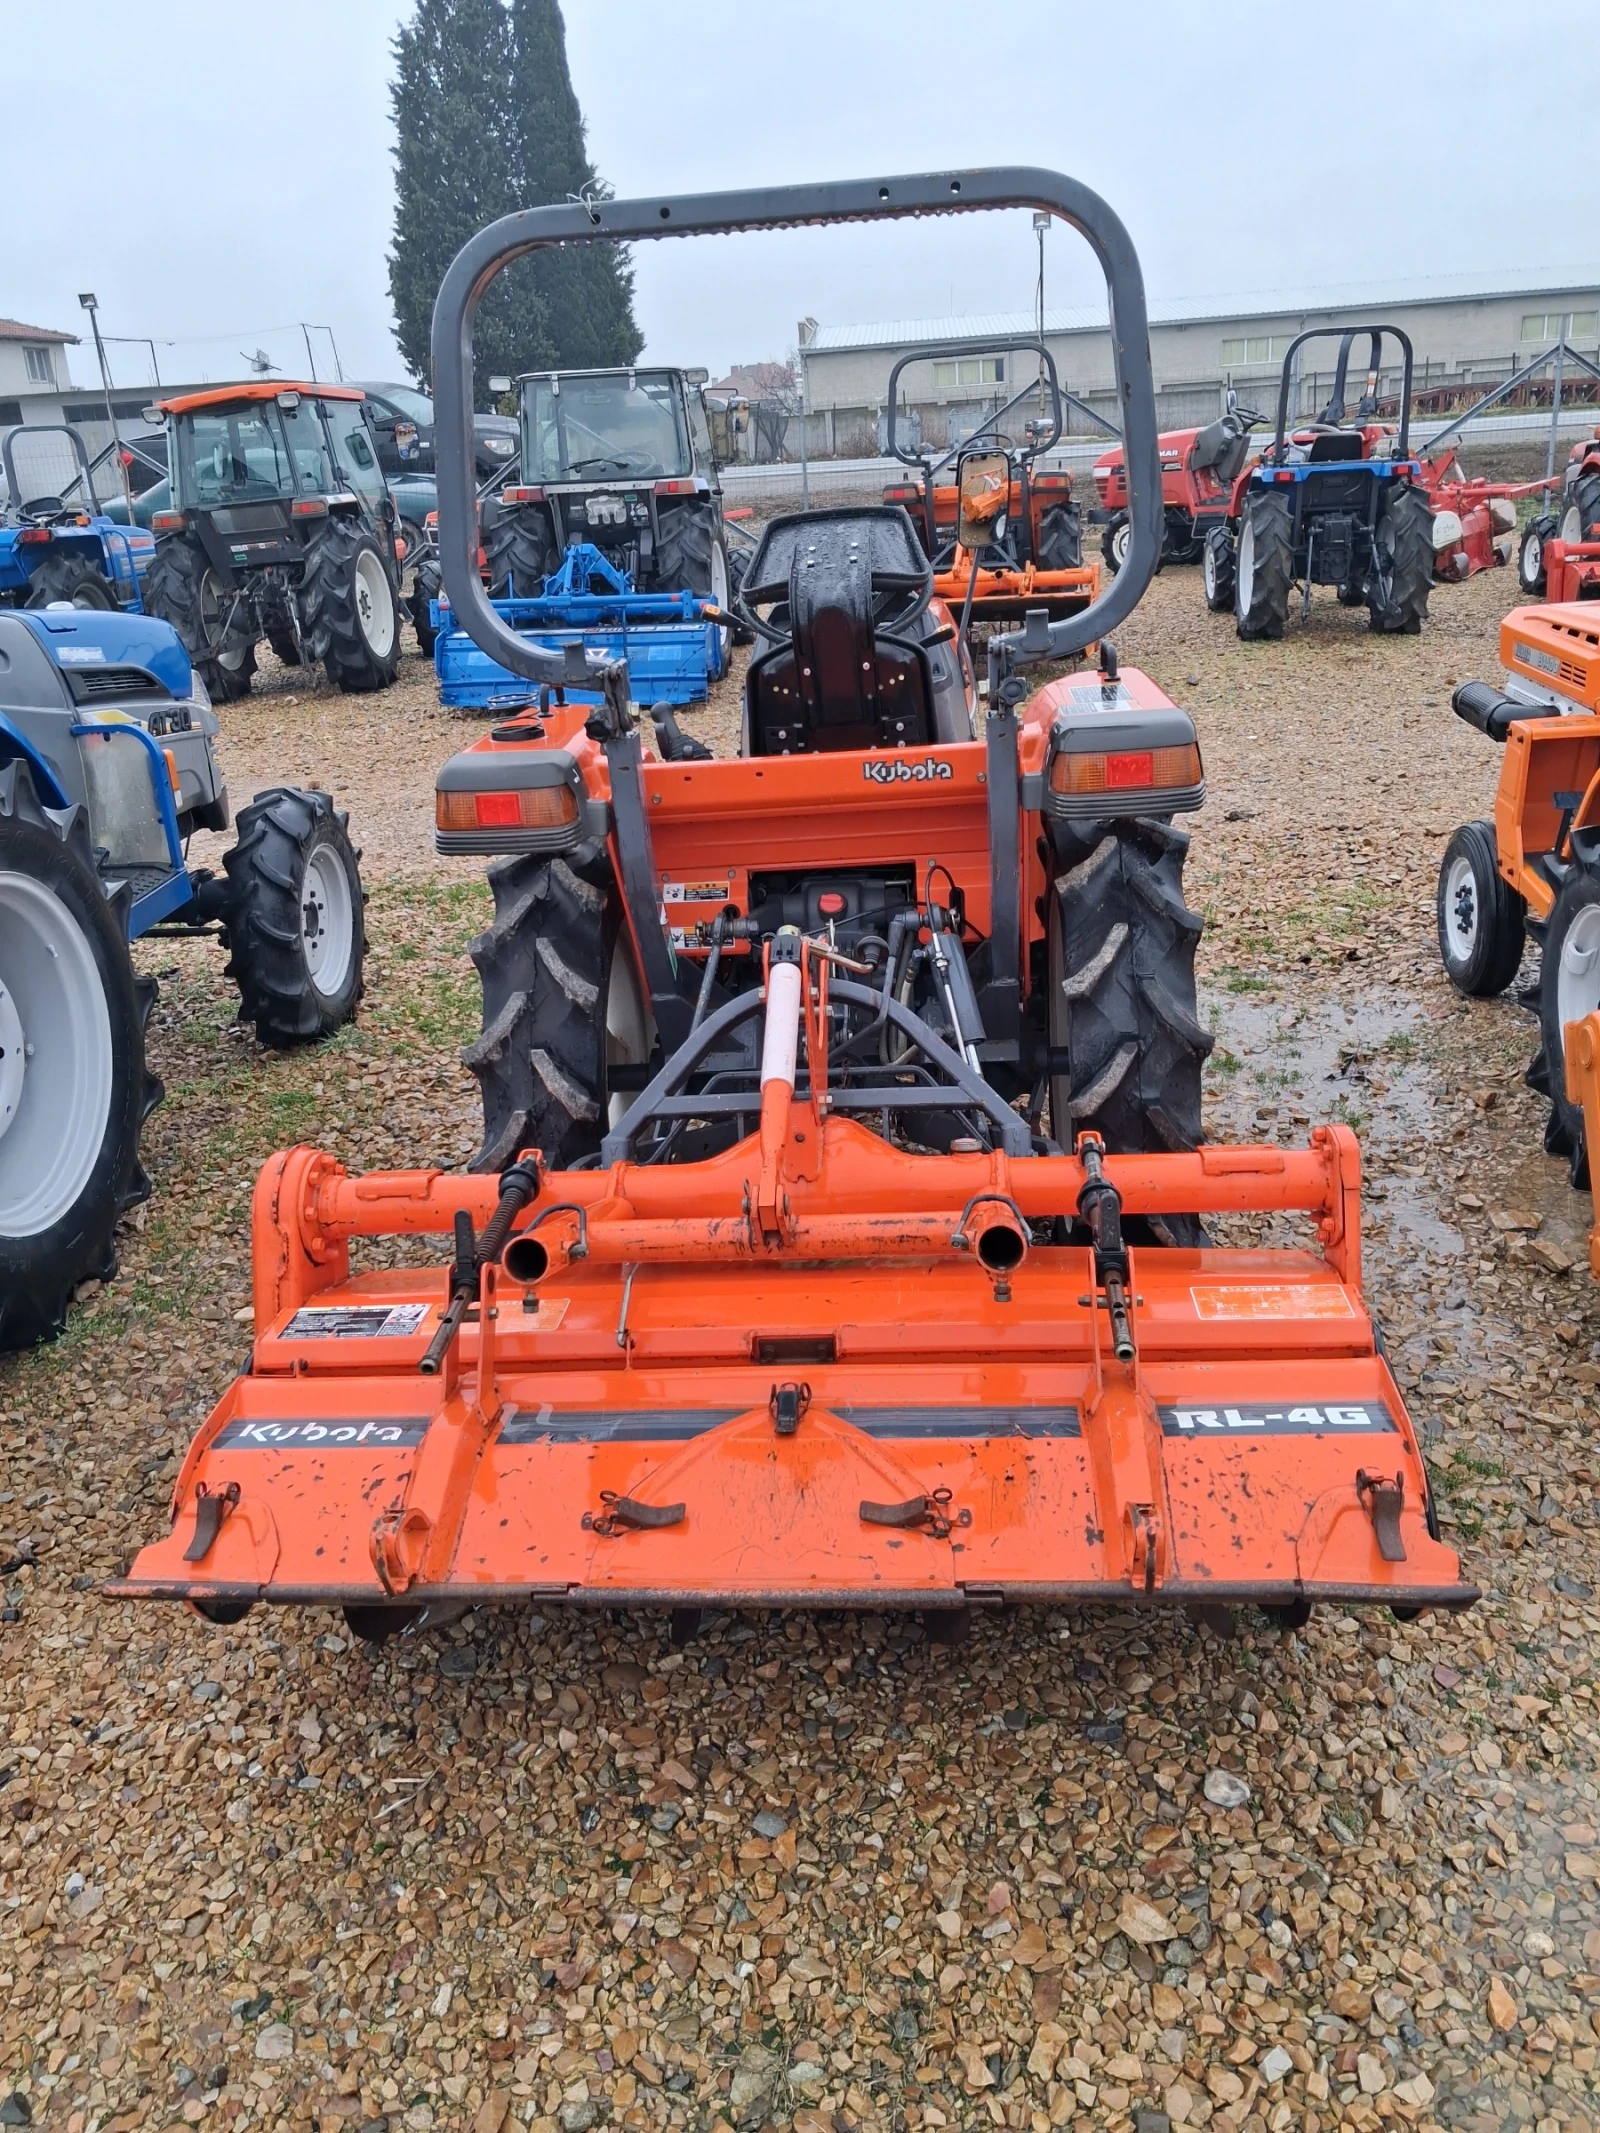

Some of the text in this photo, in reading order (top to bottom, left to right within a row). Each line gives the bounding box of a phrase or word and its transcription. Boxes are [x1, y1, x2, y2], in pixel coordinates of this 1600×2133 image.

[1159, 449, 1179, 457] MAR
[148, 706, 192, 736] AT30
[863, 758, 952, 783] Kubota
[1170, 1407, 1372, 1429] RL-4G
[239, 1422, 402, 1441] Kubota
